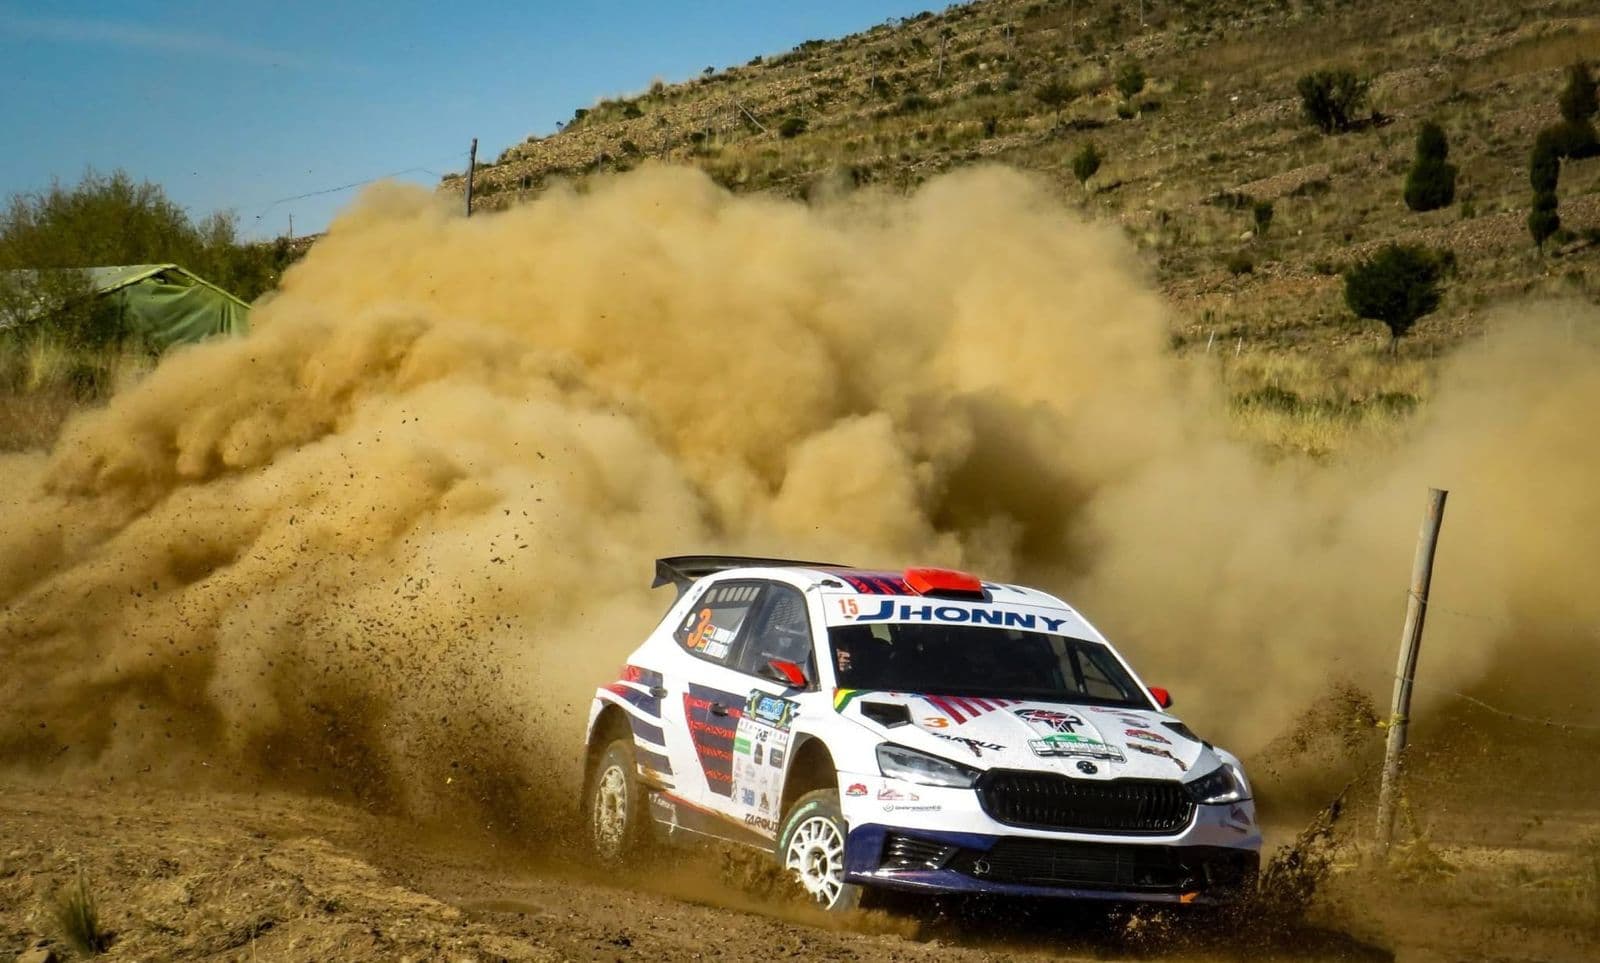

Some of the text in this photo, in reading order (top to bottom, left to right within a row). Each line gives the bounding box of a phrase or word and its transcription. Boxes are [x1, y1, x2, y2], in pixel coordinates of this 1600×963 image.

[838, 598, 859, 616] 15
[855, 600, 1068, 632] JHONNY
[922, 717, 949, 728] 3
